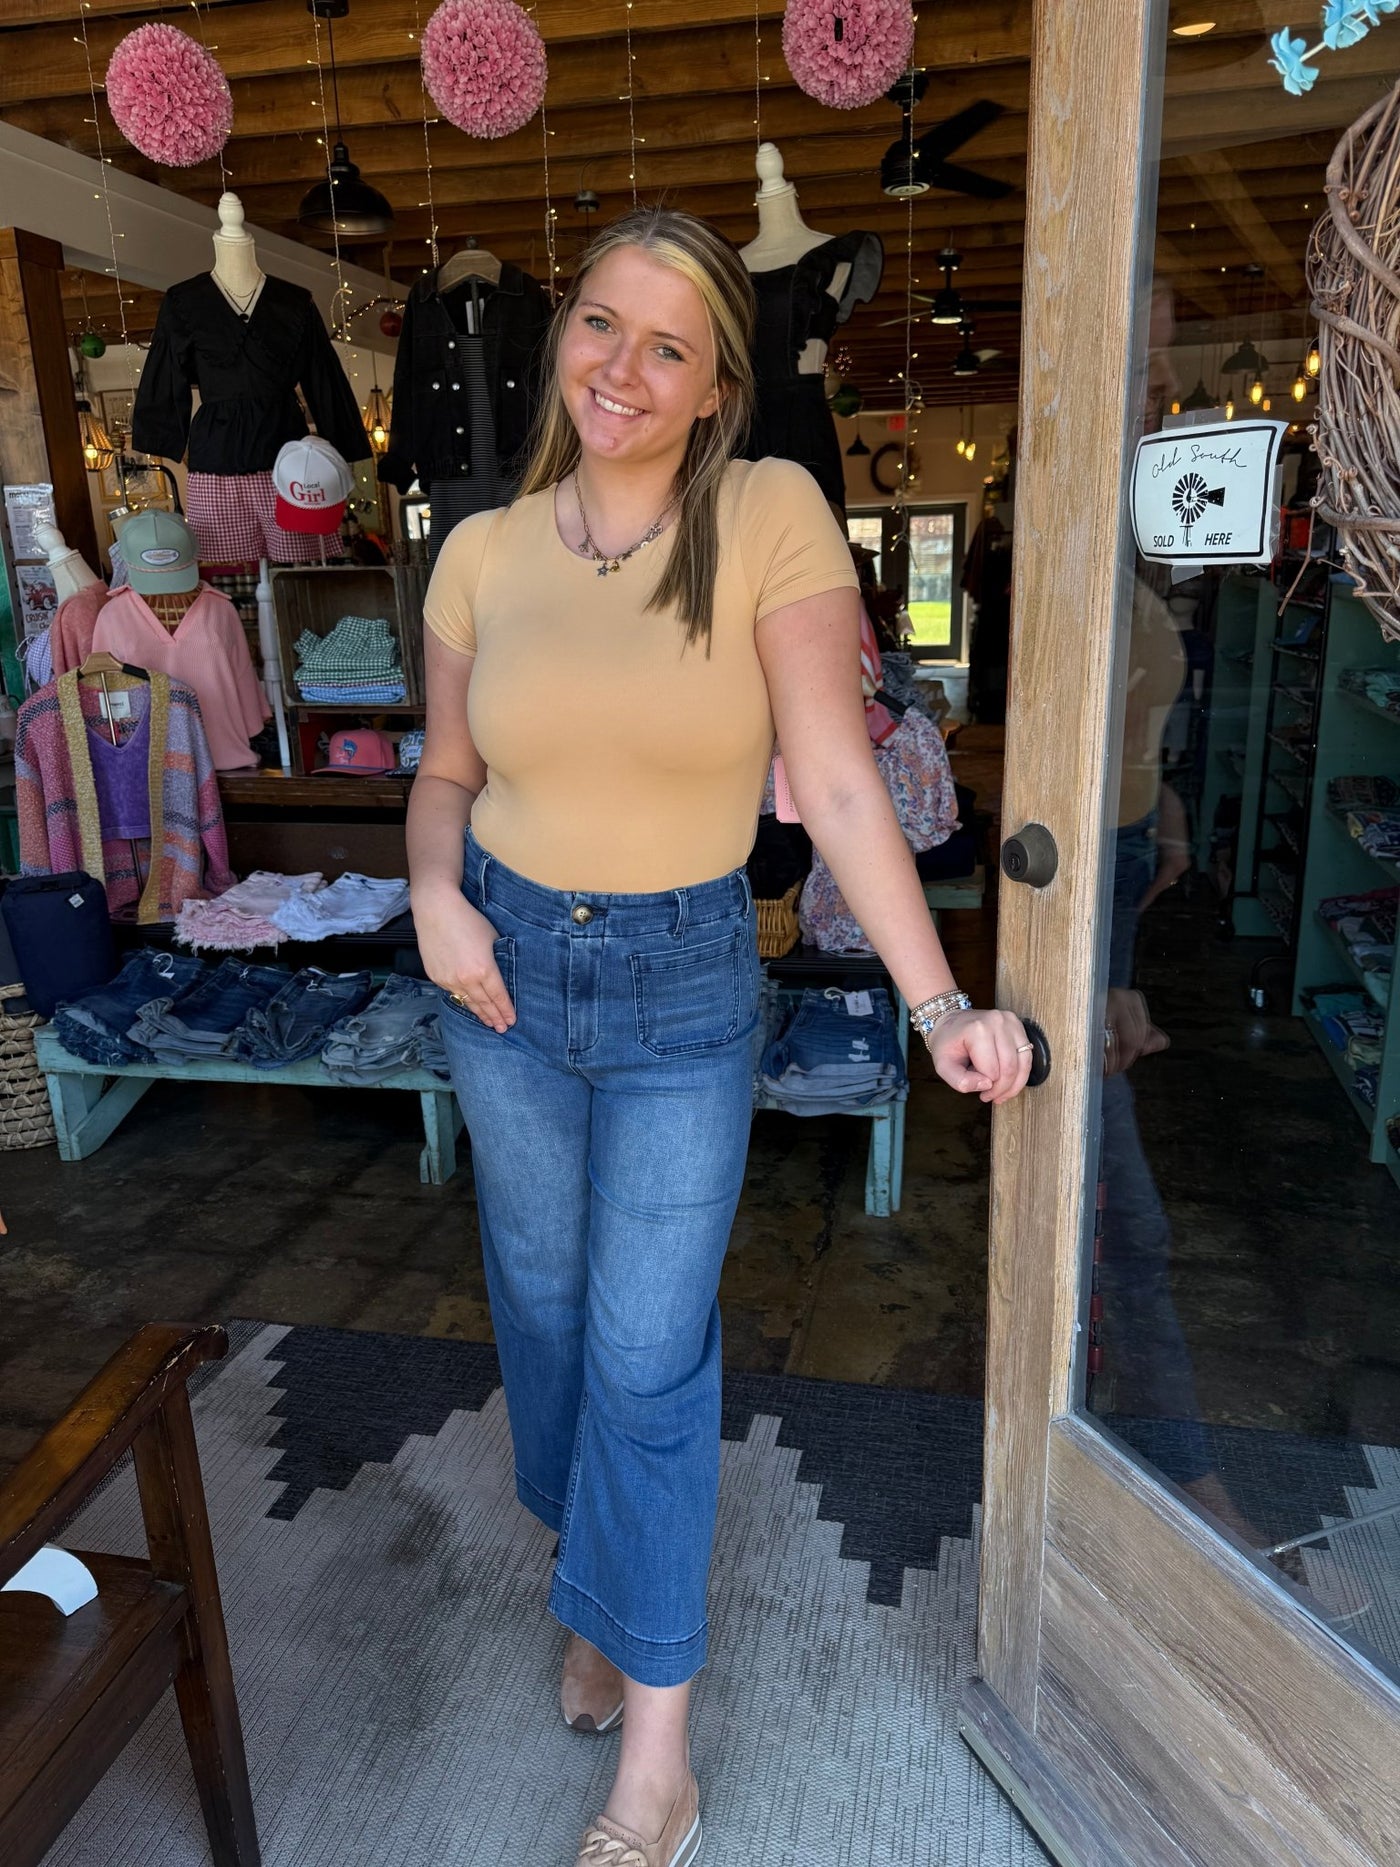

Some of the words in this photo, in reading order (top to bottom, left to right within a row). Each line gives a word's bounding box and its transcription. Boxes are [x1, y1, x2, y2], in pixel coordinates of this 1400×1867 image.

[1190, 444, 1247, 468] South
[289, 481, 326, 502] Girl
[1153, 535, 1175, 548] SOLD
[1204, 532, 1233, 546] HERE
